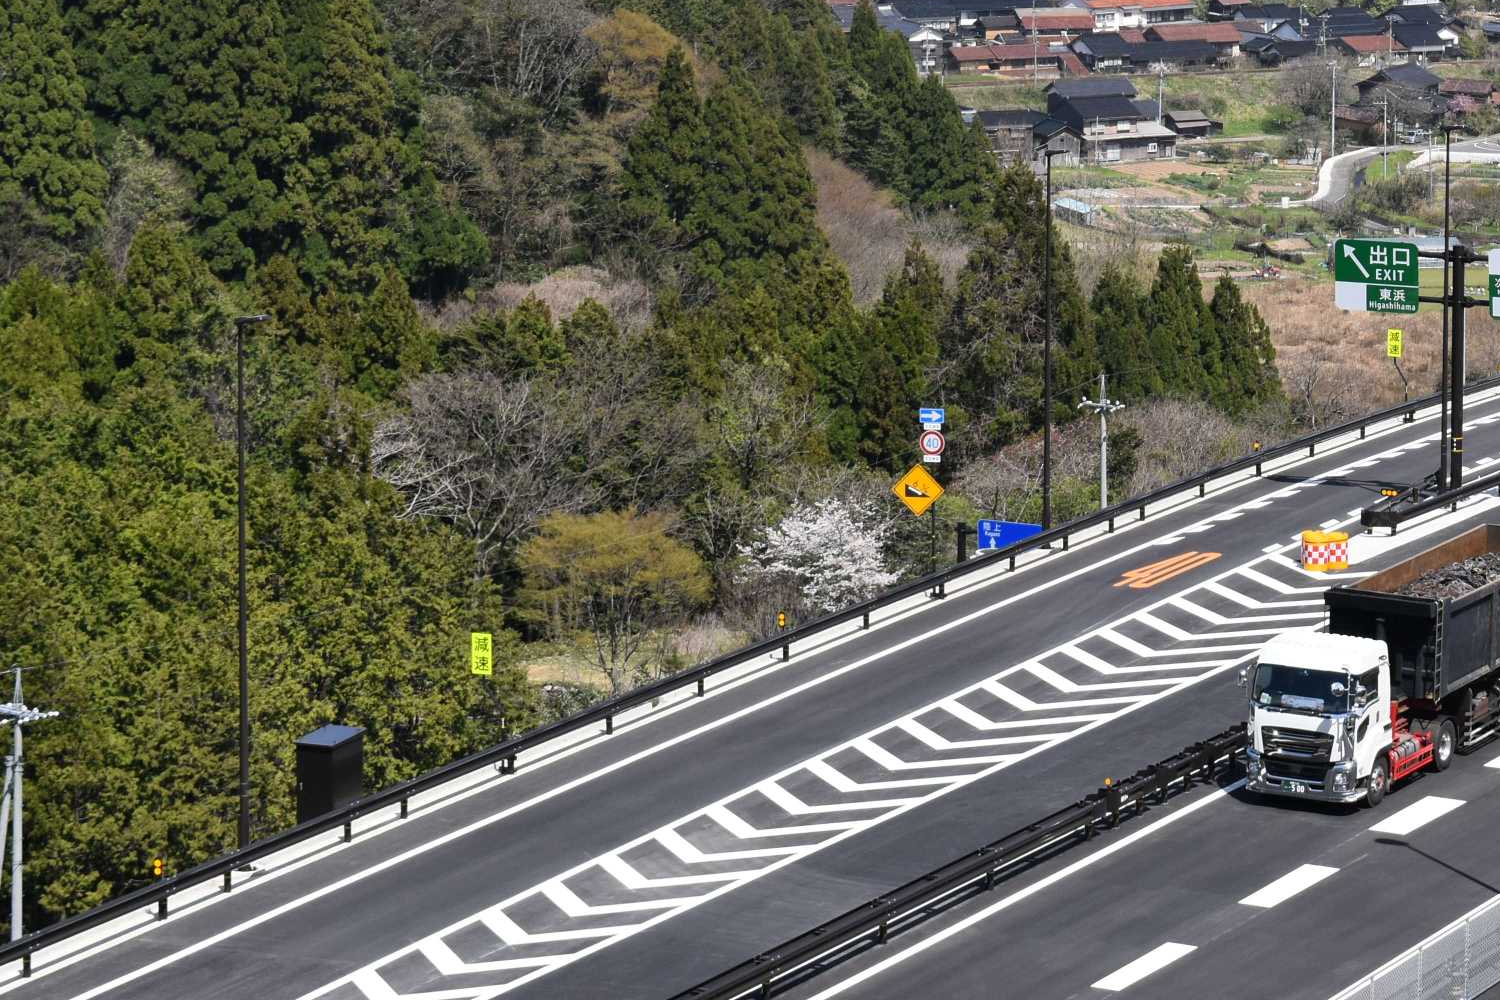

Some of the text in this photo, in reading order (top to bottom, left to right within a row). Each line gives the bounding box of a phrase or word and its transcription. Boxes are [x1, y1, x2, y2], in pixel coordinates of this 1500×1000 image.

[1369, 245, 1410, 266] 出口
[1375, 268, 1405, 281] EXIT
[1379, 288, 1406, 302] 東浜
[1369, 300, 1416, 312] Higashihama
[925, 437, 939, 449] 40
[474, 637, 489, 671] 減速
